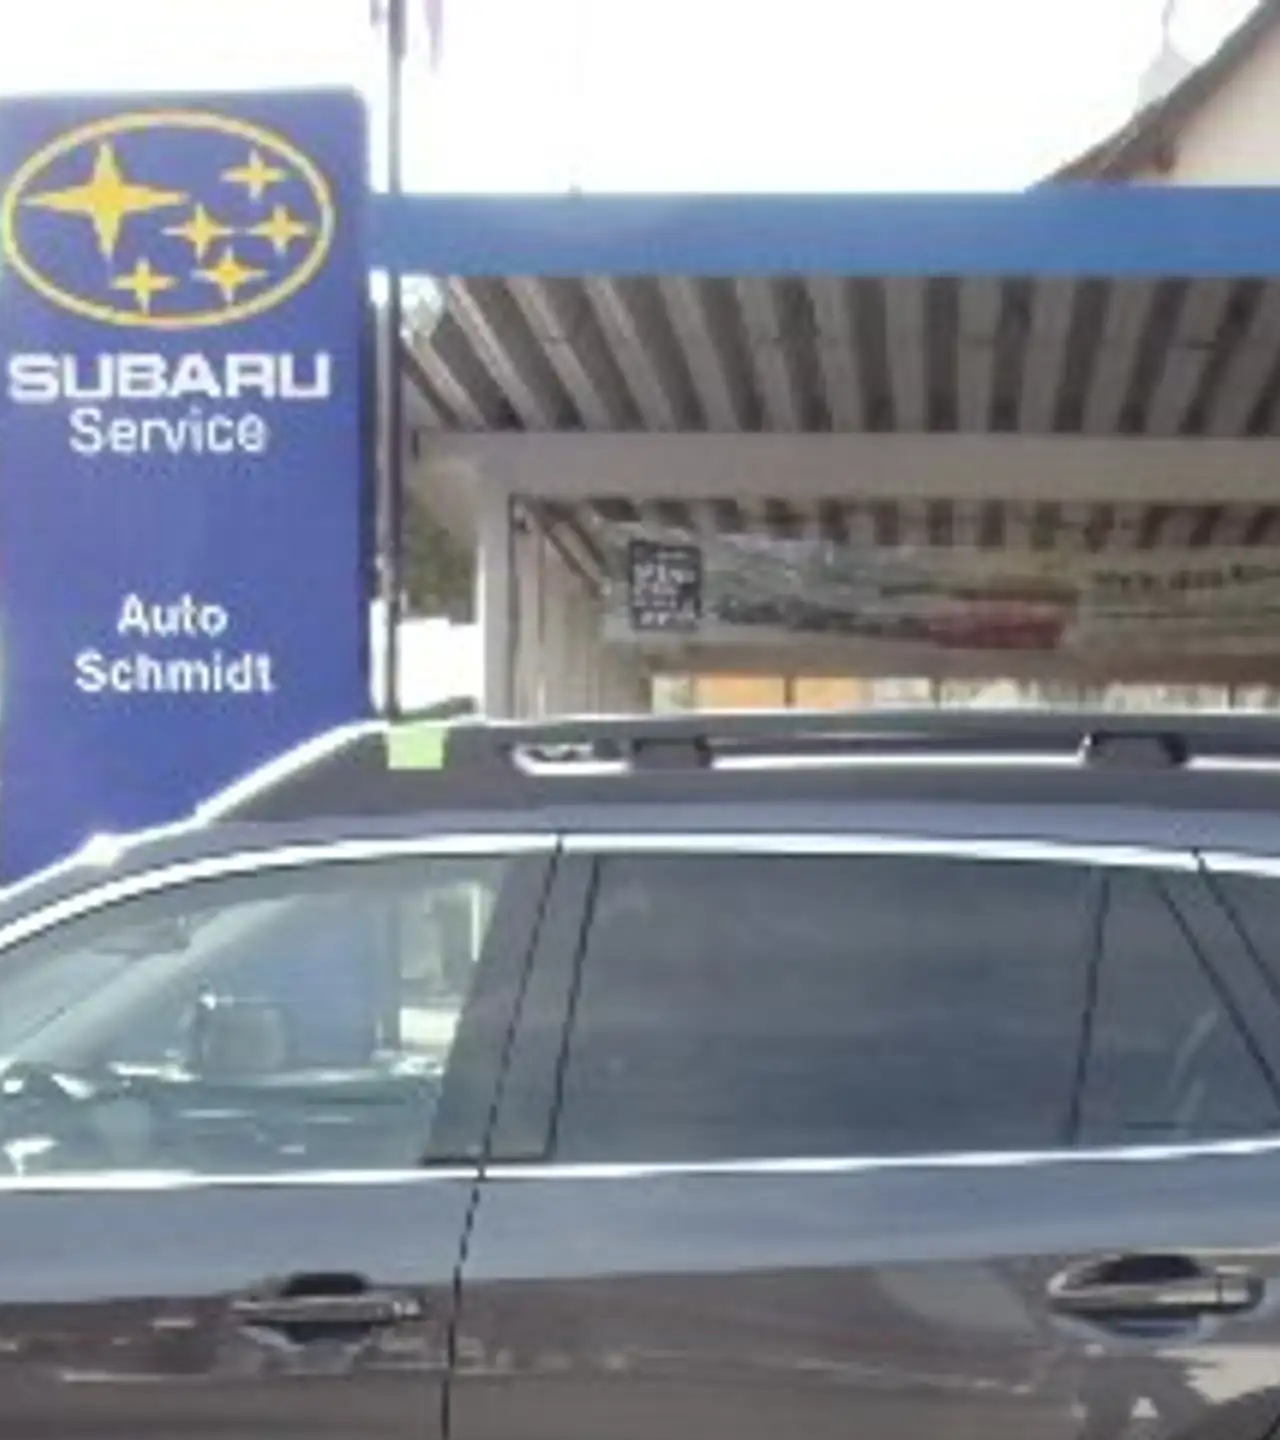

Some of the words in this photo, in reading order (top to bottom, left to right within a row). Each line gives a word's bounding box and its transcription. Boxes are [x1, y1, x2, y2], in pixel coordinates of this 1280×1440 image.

[7, 351, 332, 401] SUBARU
[68, 405, 269, 455] Service
[117, 593, 229, 636] Auto
[74, 647, 276, 693] Schmidt
